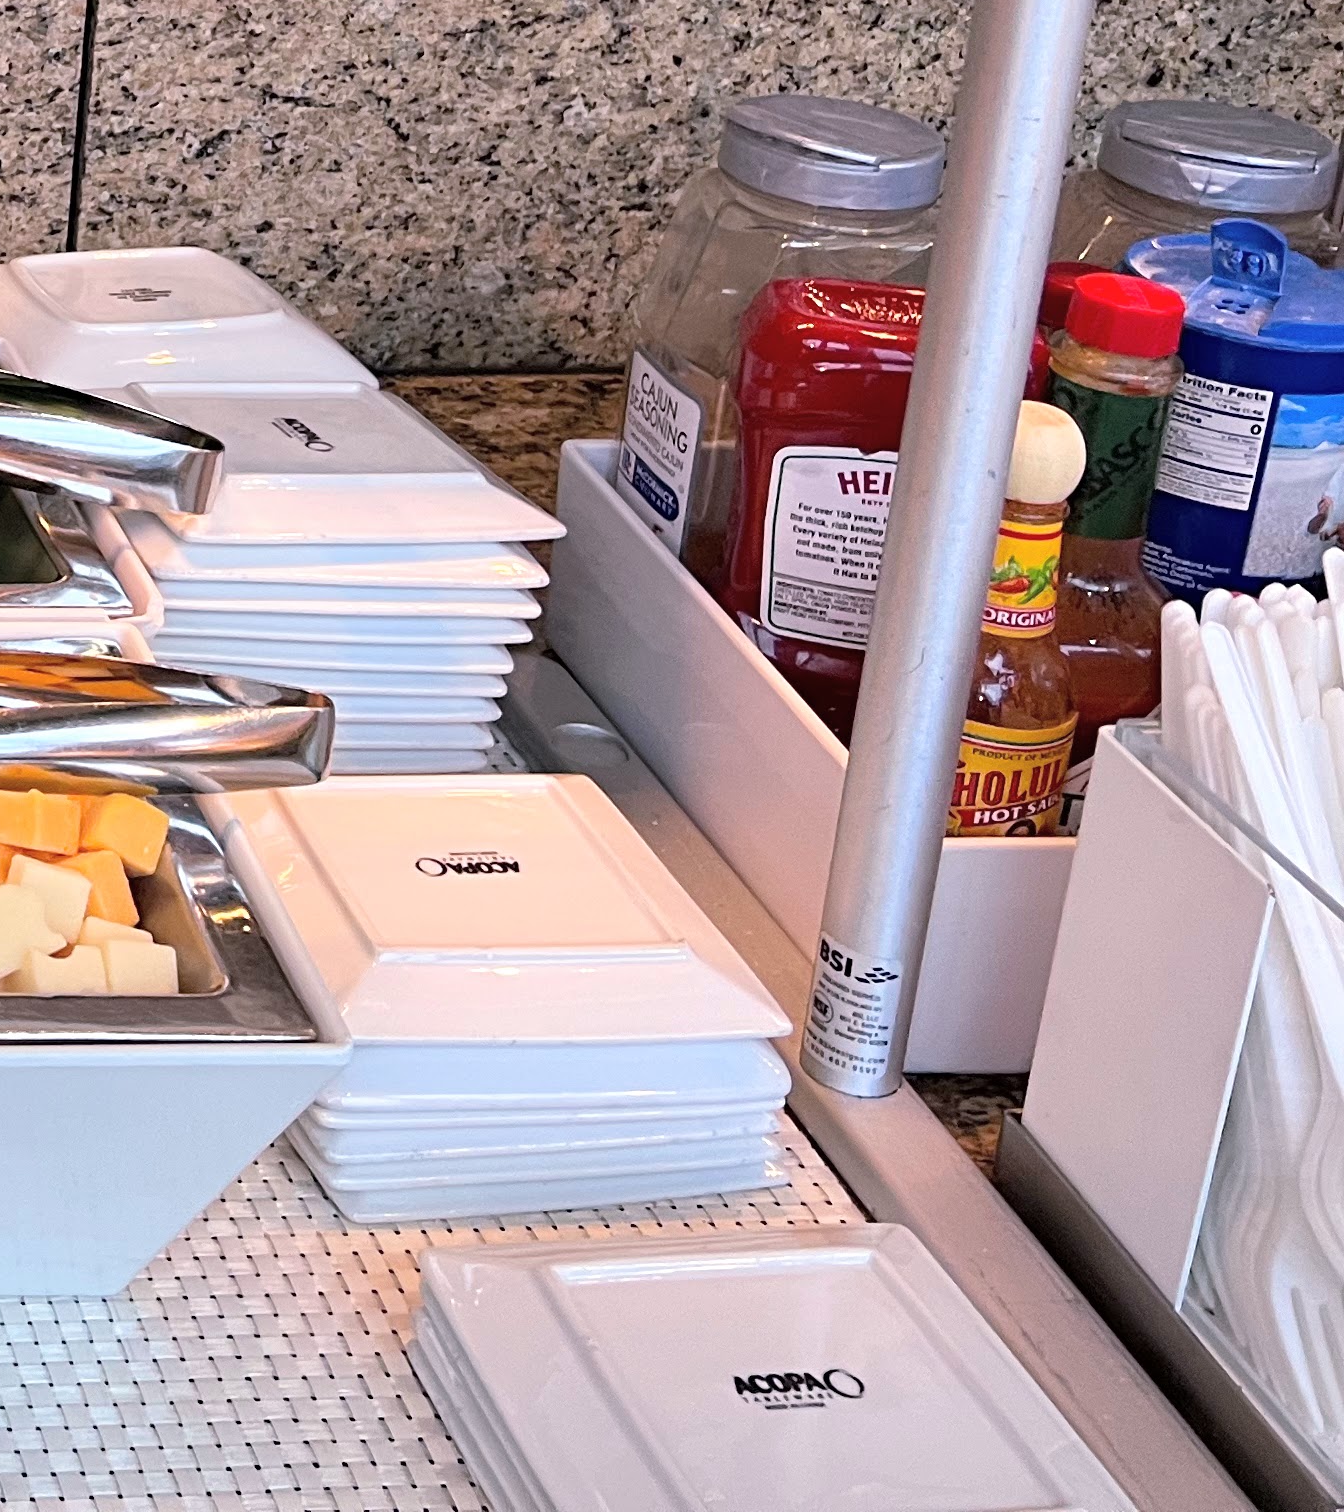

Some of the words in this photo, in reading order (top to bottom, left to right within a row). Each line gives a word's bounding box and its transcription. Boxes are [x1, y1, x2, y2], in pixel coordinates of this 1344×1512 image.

[640, 373, 679, 422] CAJUN
[1182, 375, 1224, 394] trition
[1228, 387, 1267, 402] Facts
[629, 383, 688, 454] SEASONING
[1250, 424, 1262, 435] 0
[837, 470, 892, 495] HEI
[798, 502, 812, 511] For
[814, 507, 833, 516] over
[972, 747, 1022, 761] PRODUCT
[1024, 753, 1037, 761] OF
[952, 758, 1066, 807] HOLUL
[973, 807, 1023, 824] HOT
[444, 860, 520, 875] ACOPA
[819, 938, 853, 978] BSI
[732, 1371, 828, 1395] ACOPA
